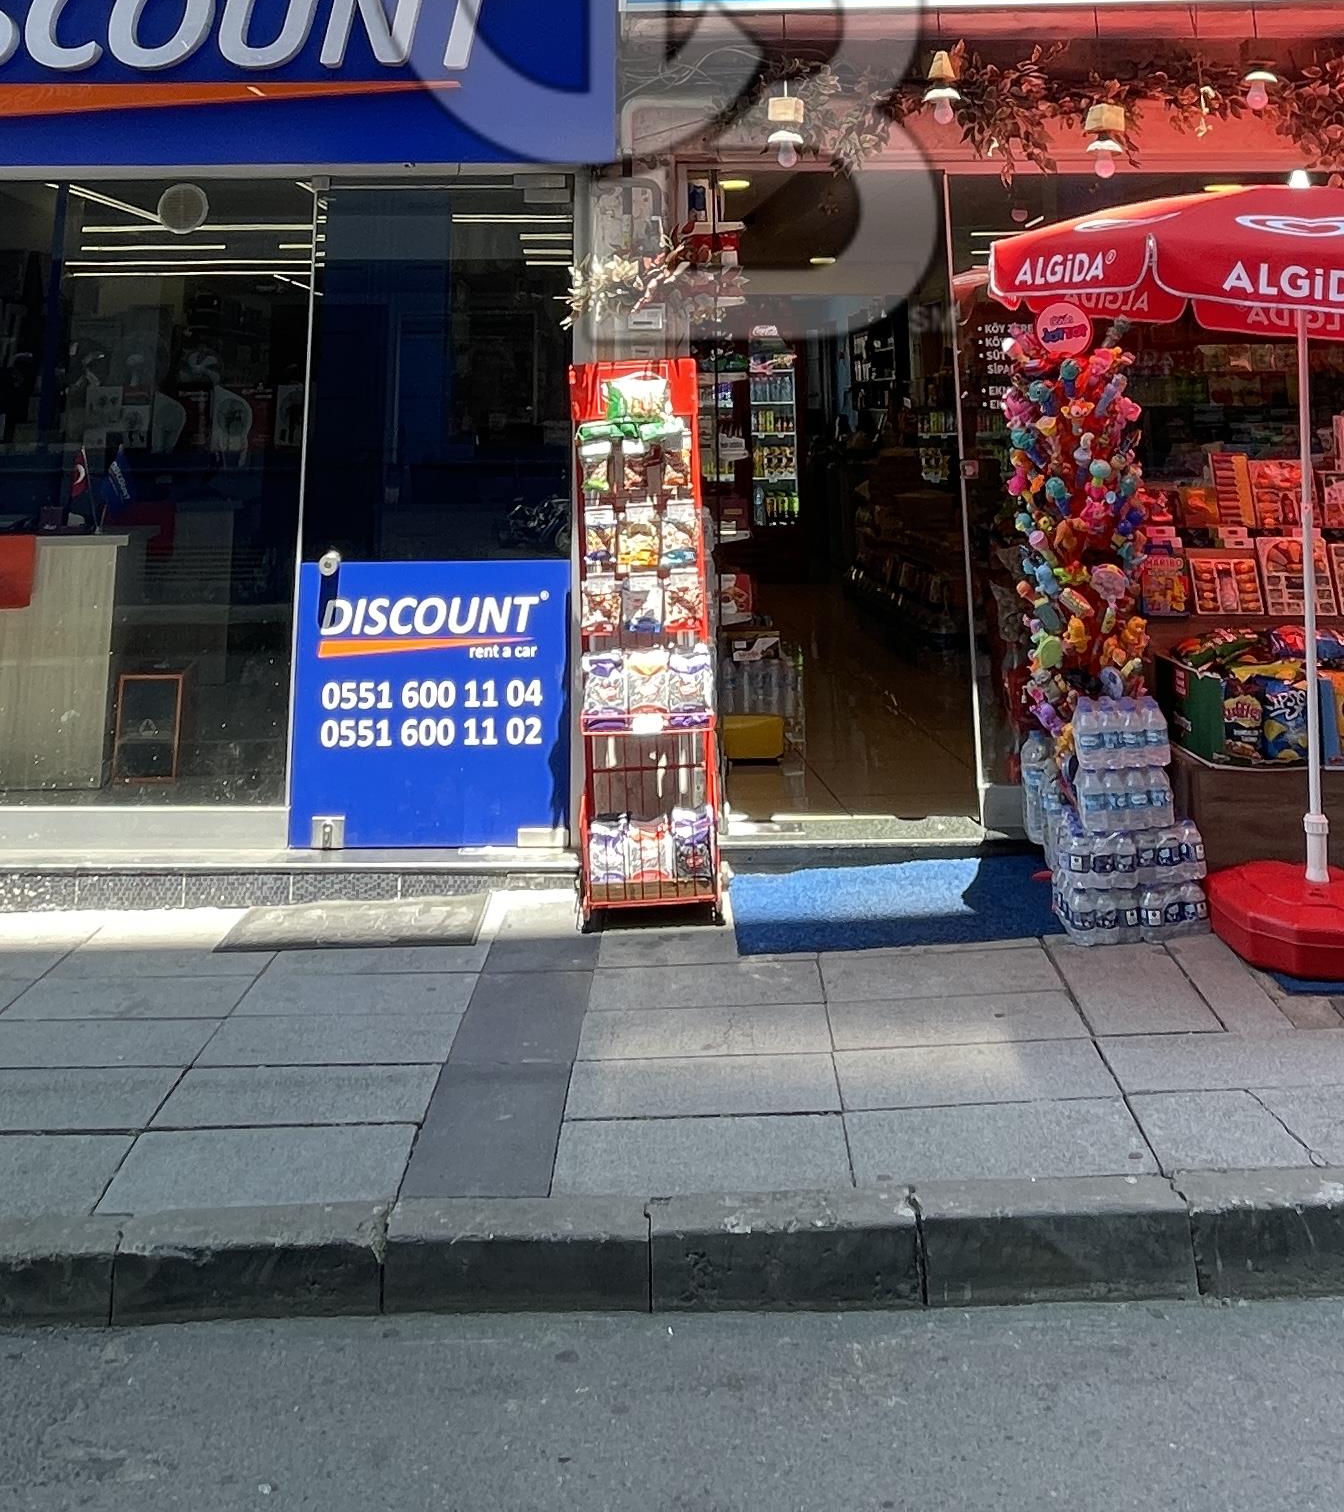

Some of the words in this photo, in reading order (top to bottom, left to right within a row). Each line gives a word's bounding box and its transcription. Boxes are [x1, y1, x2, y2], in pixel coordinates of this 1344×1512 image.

[320, 595, 540, 636] DISCOUNT
[468, 645, 500, 659] rent
[502, 648, 512, 659] a
[514, 646, 538, 659] car
[321, 681, 393, 710] 0551
[400, 680, 456, 710] 600
[463, 679, 499, 708] 11
[506, 679, 543, 708] 04
[320, 719, 393, 748] 0551
[400, 718, 455, 747] 600
[463, 717, 498, 746] 11
[505, 717, 543, 746] 02
